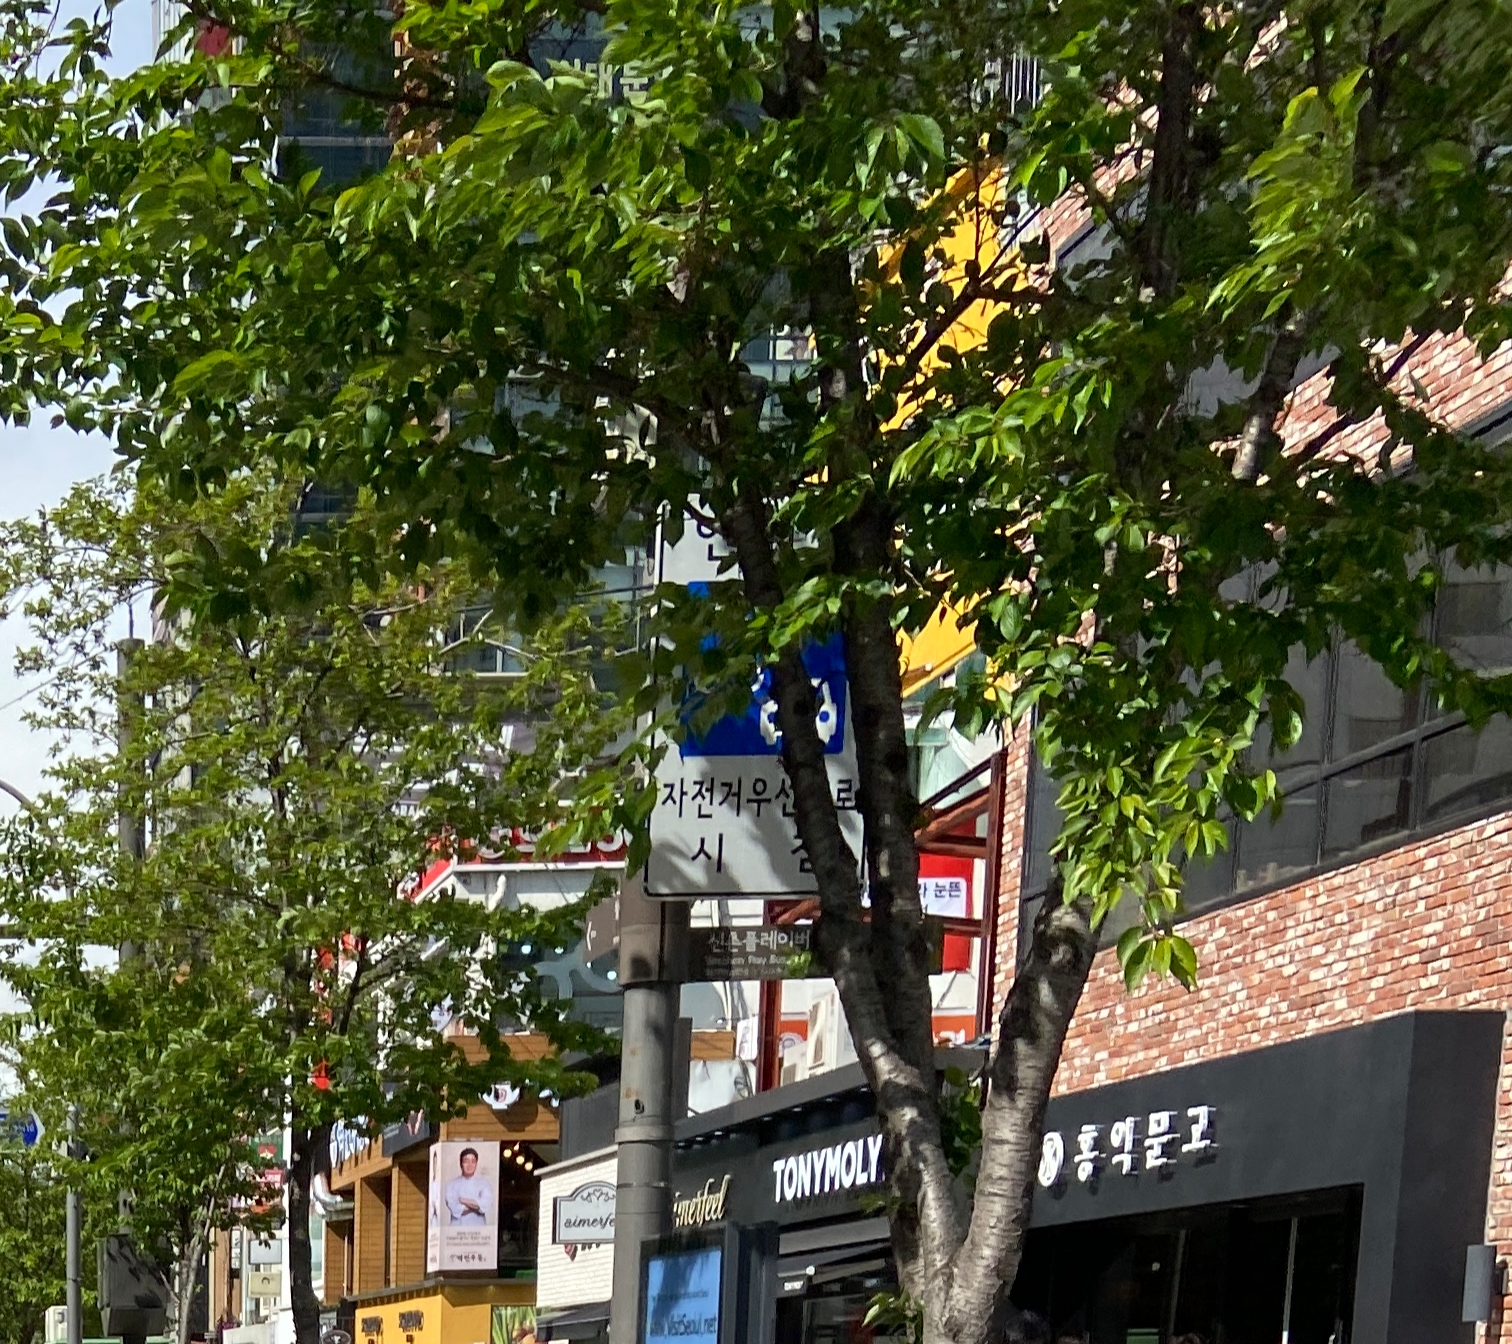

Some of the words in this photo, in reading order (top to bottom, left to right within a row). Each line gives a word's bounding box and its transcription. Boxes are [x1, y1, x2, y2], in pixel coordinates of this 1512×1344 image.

[662, 776, 856, 819] 자전거우선로
[707, 929, 811, 953] 신촌플레이버
[773, 1133, 884, 1203] TONYMOLY
[1073, 1105, 1215, 1183] 홍익문고
[563, 1212, 615, 1230] aimerfe
[673, 1173, 731, 1228] imerfeel
